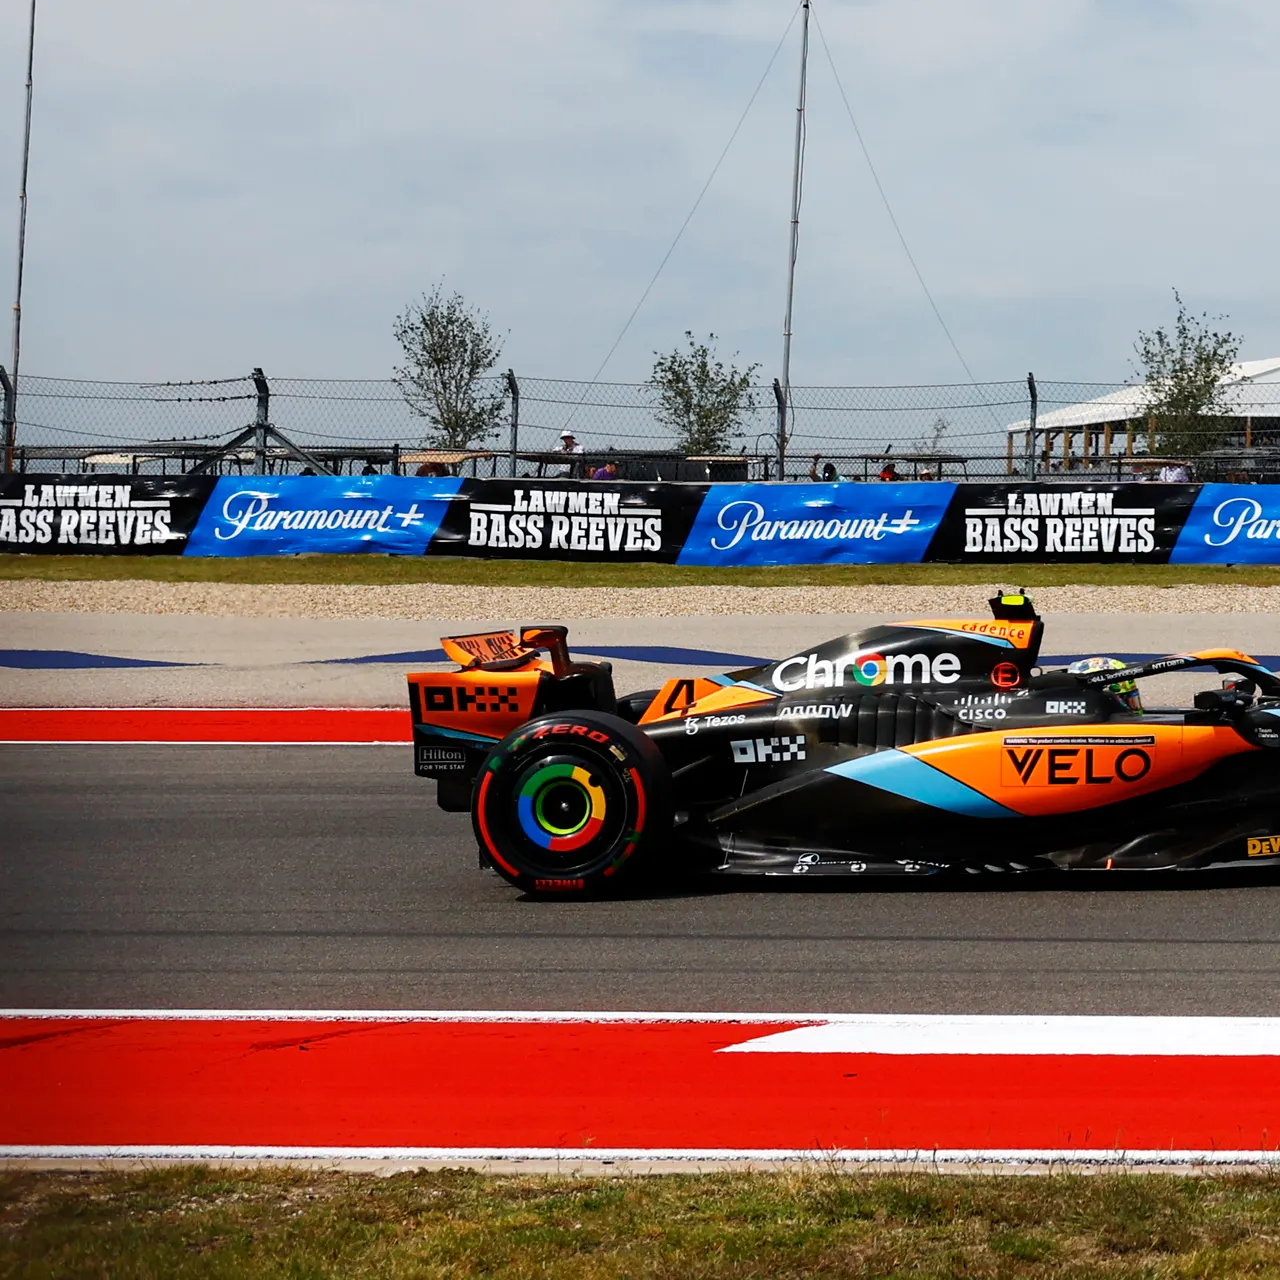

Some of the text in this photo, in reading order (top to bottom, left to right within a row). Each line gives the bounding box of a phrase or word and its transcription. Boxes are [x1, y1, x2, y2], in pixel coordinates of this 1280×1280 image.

[23, 484, 132, 508] LAWMEN
[513, 489, 621, 513] LAWMEN
[1007, 492, 1115, 516] LAWMEN
[0, 508, 172, 545] ASS REEVES
[214, 490, 425, 541] Paramount+
[711, 500, 920, 550] Paramount+
[468, 511, 662, 552] BASS REEVES
[965, 517, 1155, 553] BASS REEVES
[771, 652, 961, 691] Chrome
[423, 686, 519, 712] OKX
[663, 679, 698, 717] 4
[1045, 701, 1086, 714] OKX
[704, 713, 746, 728] Tezos
[958, 707, 1007, 720] CISCO
[532, 724, 611, 743] ZERO
[423, 749, 462, 760] Hilton
[730, 735, 806, 763] OKX
[1006, 747, 1152, 785] VELO
